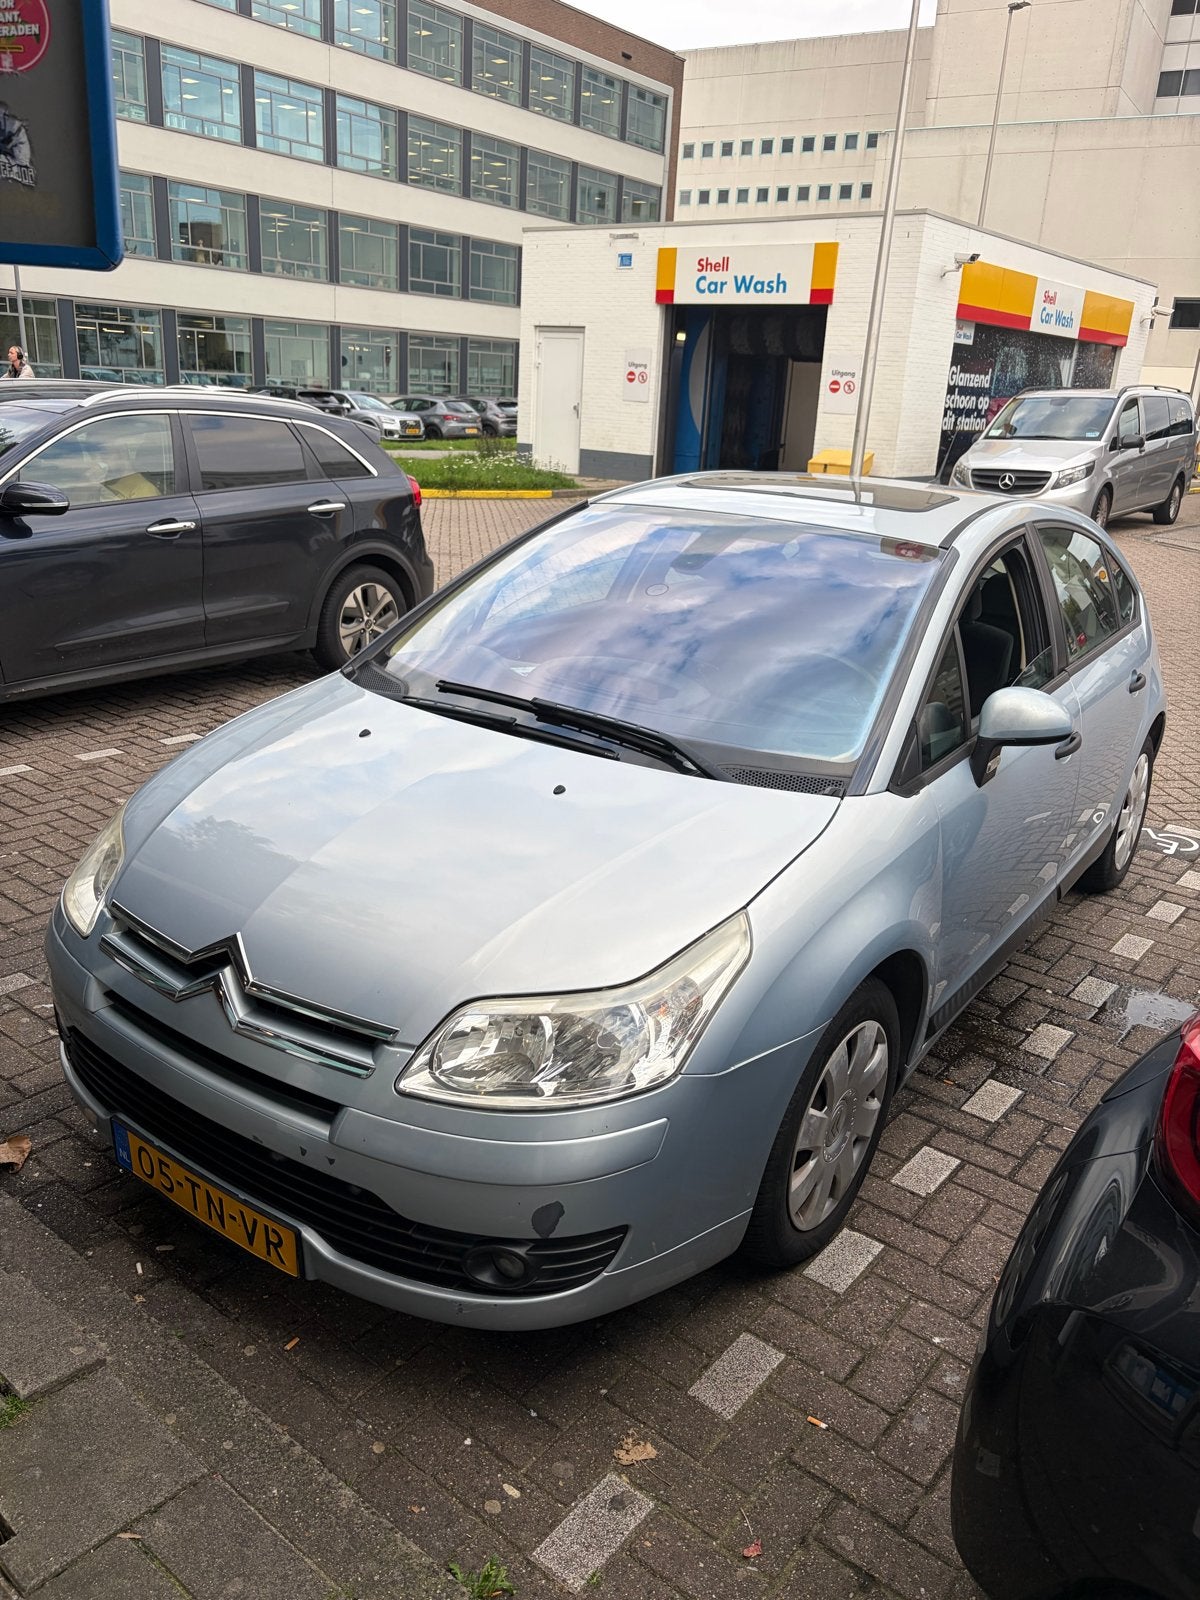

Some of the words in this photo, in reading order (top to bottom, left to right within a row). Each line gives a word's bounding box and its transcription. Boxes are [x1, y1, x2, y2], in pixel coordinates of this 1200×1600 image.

[697, 256, 729, 272] Shell
[696, 275, 727, 294] Car
[733, 273, 787, 294] Wash
[1043, 290, 1058, 305] Shell
[1040, 306, 1053, 325] Car
[1055, 309, 1073, 328] Wash
[831, 369, 856, 378] Uitgang
[948, 365, 992, 388] Glanzend
[944, 388, 976, 409] schoon
[977, 396, 989, 415] op
[942, 410, 955, 431] dit
[956, 412, 986, 431] station
[137, 1145, 287, 1266] 05-TN-VR
